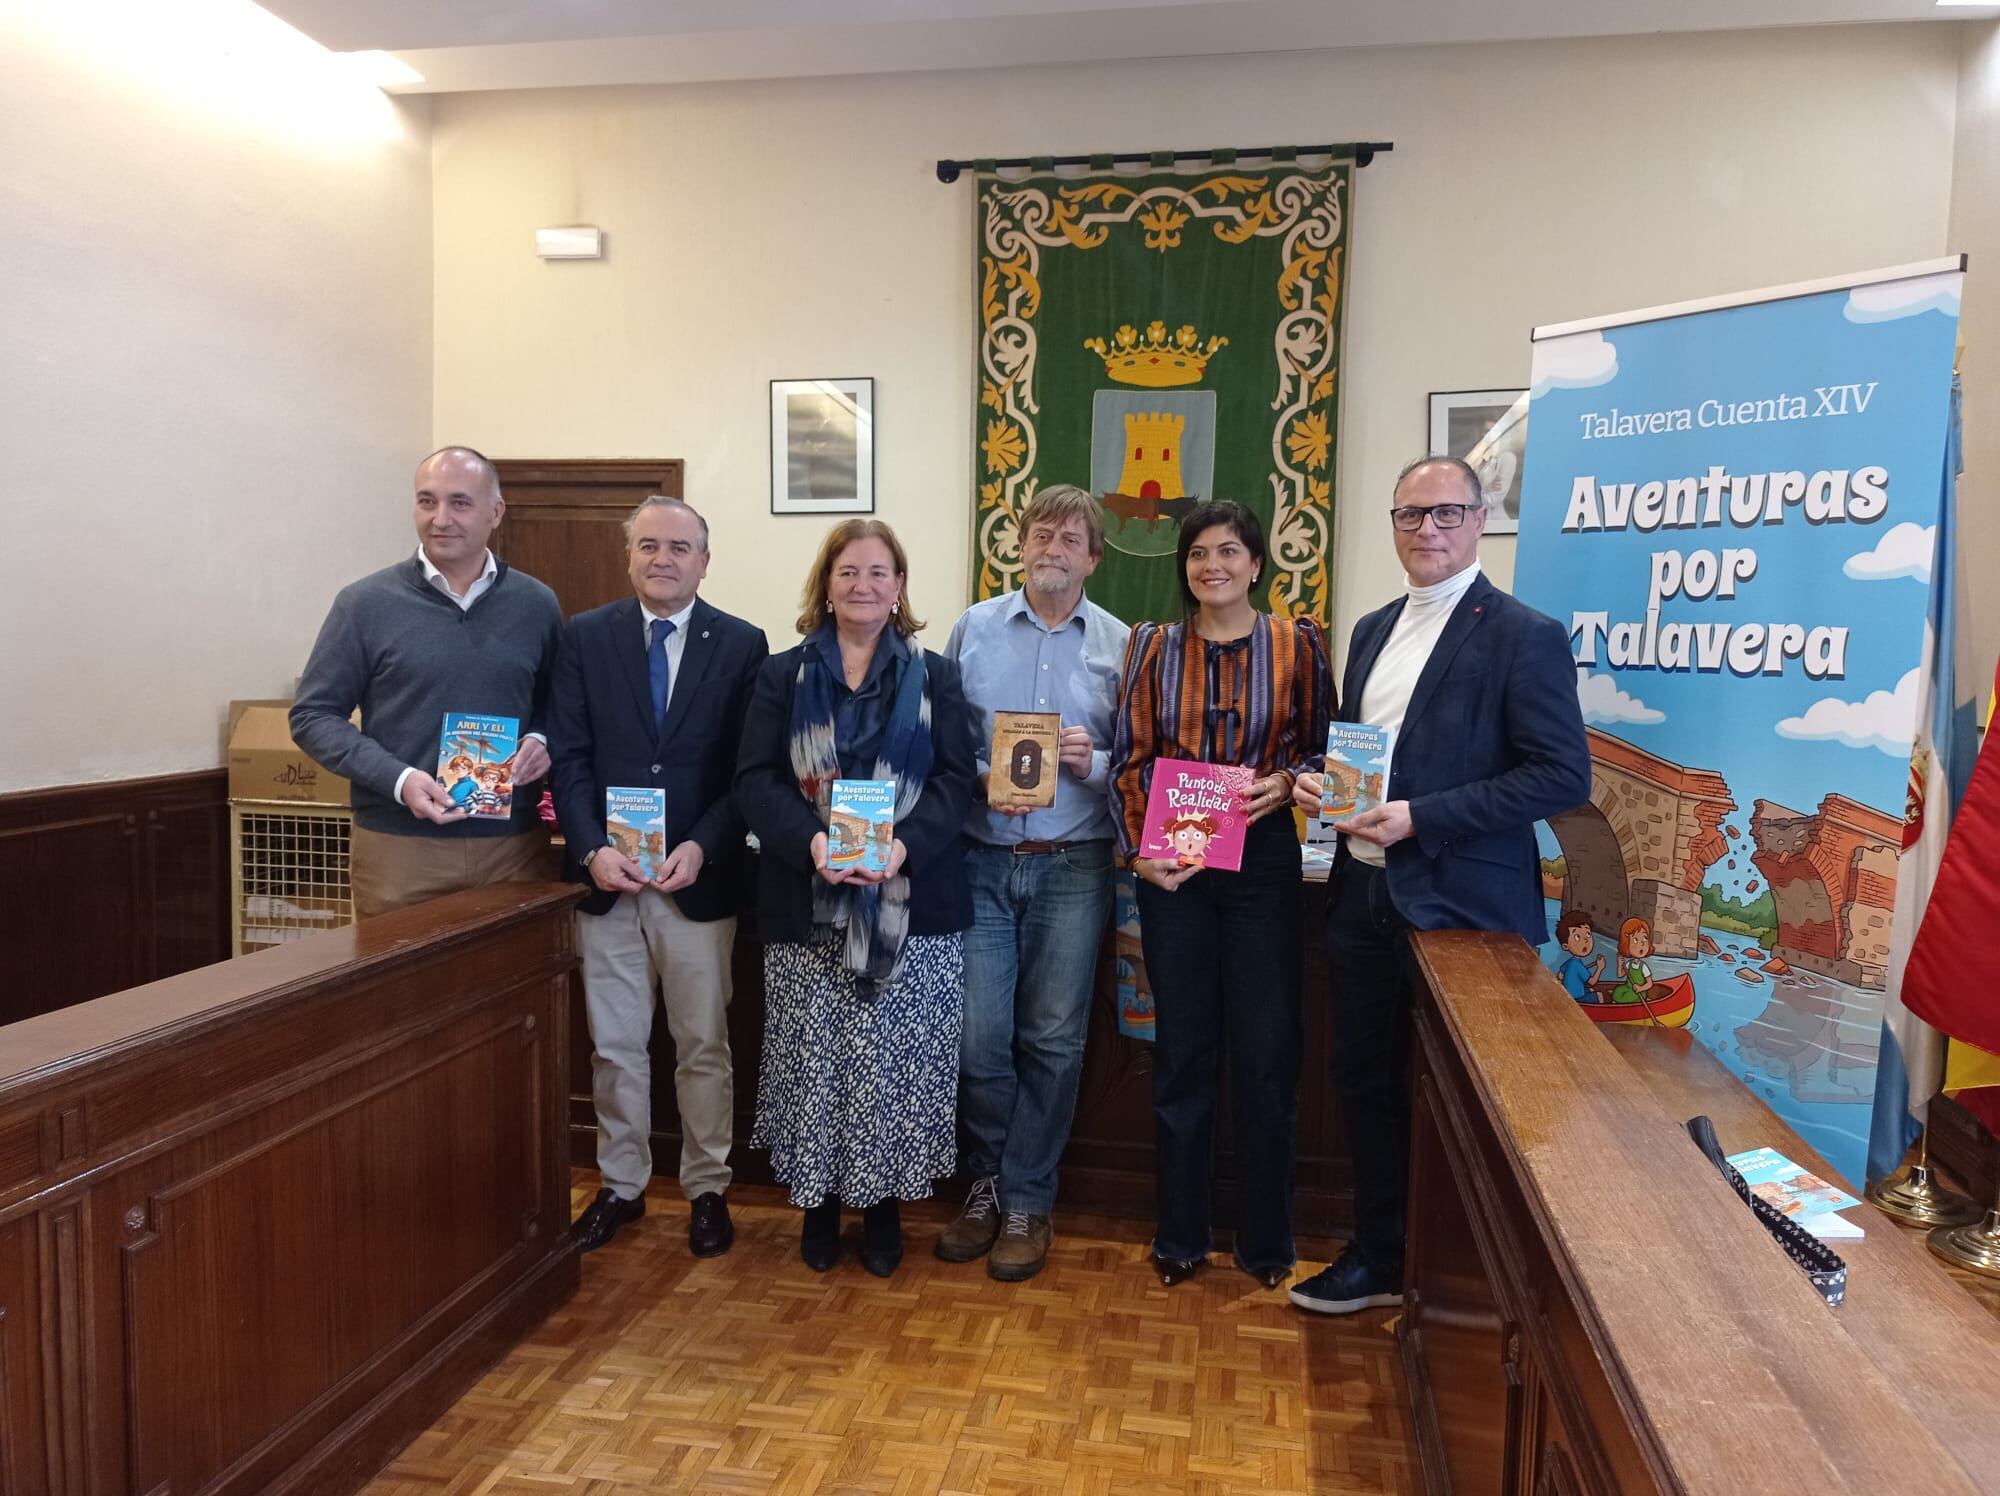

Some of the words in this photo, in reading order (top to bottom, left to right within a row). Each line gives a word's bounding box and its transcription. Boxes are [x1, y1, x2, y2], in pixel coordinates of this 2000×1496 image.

[1580, 408, 1692, 440] Talavera
[1698, 394, 1808, 429] Cuenta
[1814, 382, 1879, 416] XIV
[1562, 465, 1889, 533] Aventuras
[1648, 547, 1758, 610] por
[1570, 608, 1848, 680] Talavera
[457, 721, 480, 730] ARRI
[482, 723, 490, 731] Y
[1338, 730, 1378, 740] Aventuras
[1333, 739, 1347, 748] por
[1347, 740, 1382, 750] Talavera
[1177, 772, 1213, 790] Punto
[1214, 781, 1226, 794] de
[843, 786, 885, 794] Aventuras
[616, 795, 654, 803] Aventuras
[838, 795, 853, 803] por
[1166, 789, 1232, 812] Realidad
[611, 804, 625, 812] por
[625, 804, 659, 812] Talavera
